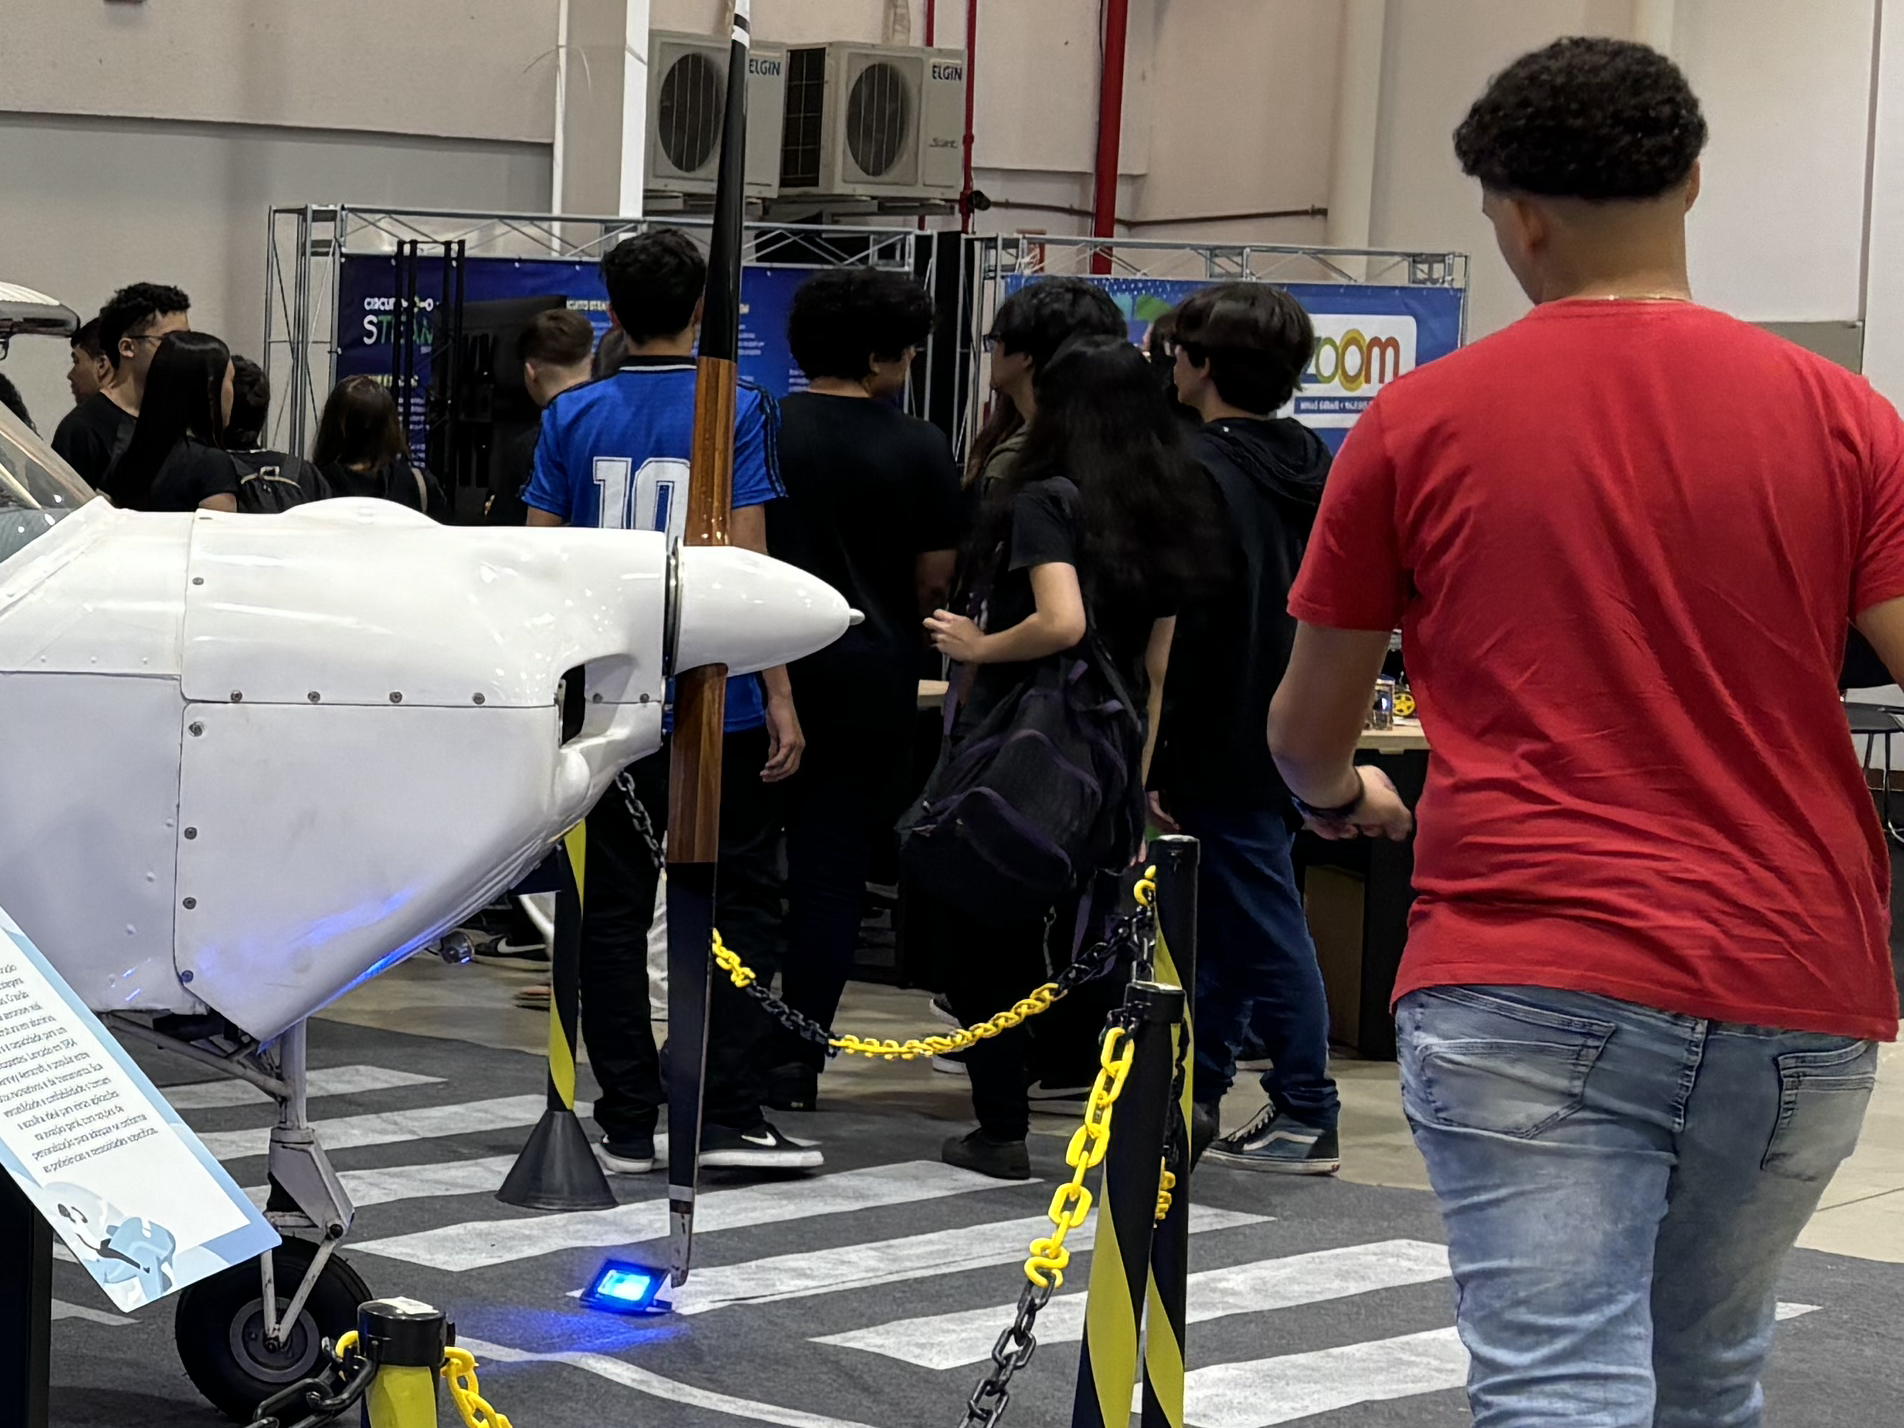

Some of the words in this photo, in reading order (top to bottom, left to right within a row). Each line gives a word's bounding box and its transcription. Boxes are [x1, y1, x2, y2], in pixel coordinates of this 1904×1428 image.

[749, 58, 781, 77] ELGIN
[932, 64, 962, 82] ELGIN
[593, 456, 690, 549] 10
